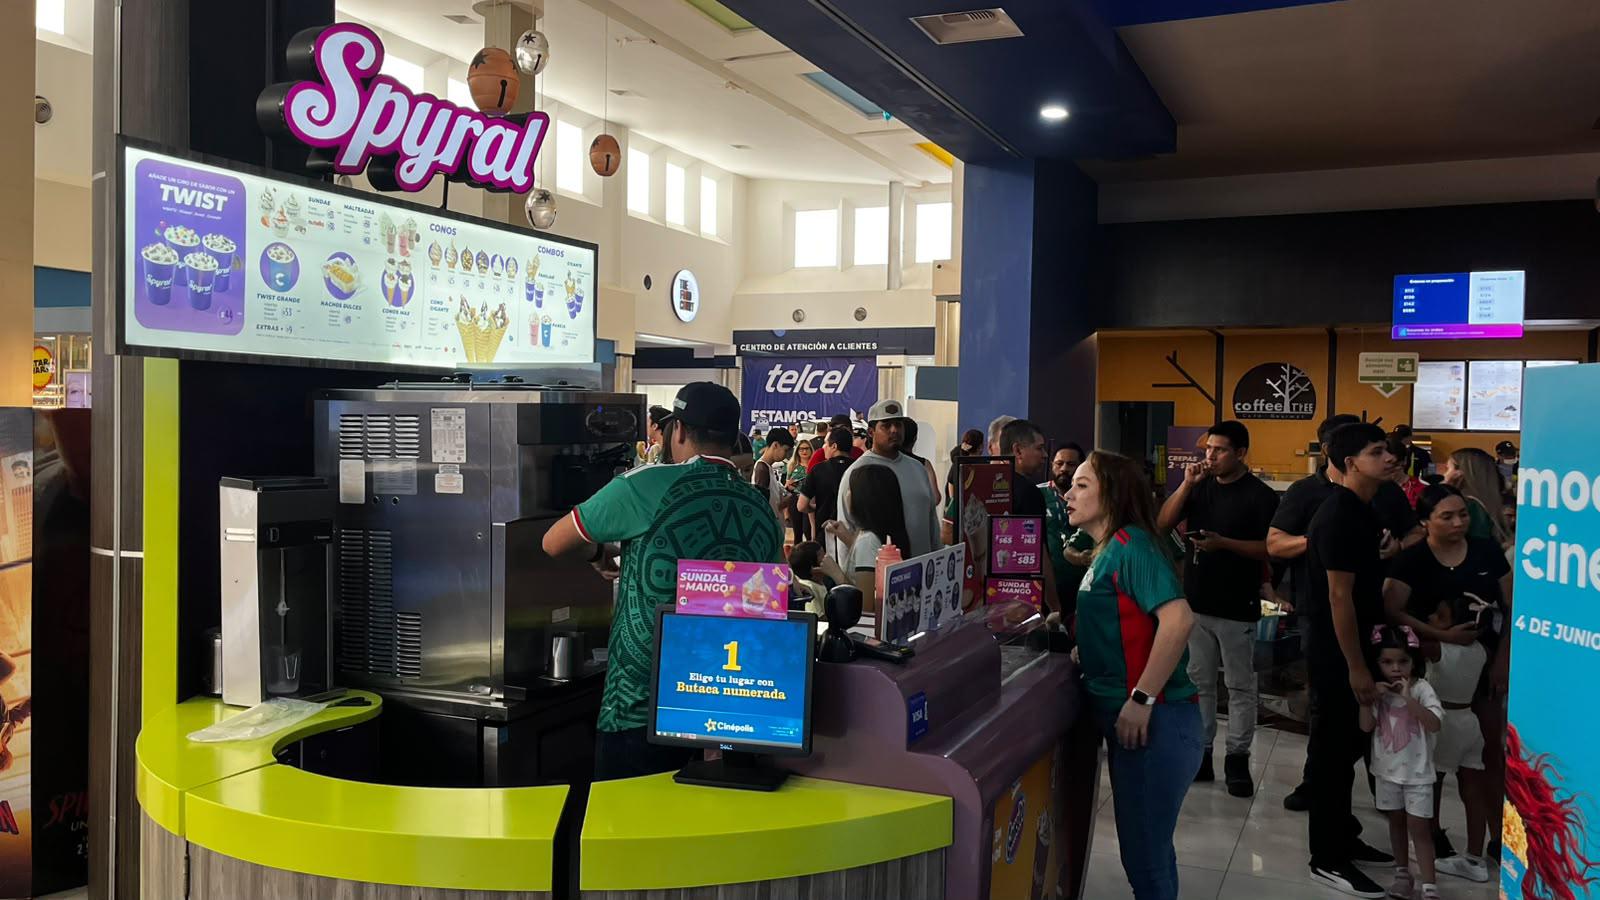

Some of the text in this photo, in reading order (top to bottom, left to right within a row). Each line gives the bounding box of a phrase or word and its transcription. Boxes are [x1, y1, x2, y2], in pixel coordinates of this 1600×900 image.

[287, 26, 547, 190] Spyral
[160, 183, 228, 212] TWIST
[429, 223, 457, 236] CONOS
[537, 245, 565, 258] COMBOS
[146, 273, 172, 288] Spyral
[189, 279, 213, 293] Spyral
[276, 295, 301, 304] GRANDE
[256, 323, 279, 332] EXTRAS
[774, 343, 785, 351] DE
[787, 341, 827, 351] ATENCIÓN
[837, 342, 878, 350] CLIENTES
[33, 359, 50, 367] TAR
[765, 363, 856, 394] telcel
[1235, 399, 1283, 412] coffee
[751, 409, 817, 423] ESTAMOS
[1017, 556, 1036, 565] $85
[680, 572, 727, 583] SUNDAE
[685, 582, 729, 593] MANGO
[998, 581, 1031, 589] SUNDAE
[1001, 587, 1032, 595] MANGO
[1515, 614, 1600, 651] 4 DE JUNIO
[722, 641, 742, 671] 1
[689, 672, 774, 687] Elige tu lugar con
[676, 681, 787, 700] Butaca numerada
[716, 721, 755, 733] Cinépolis
